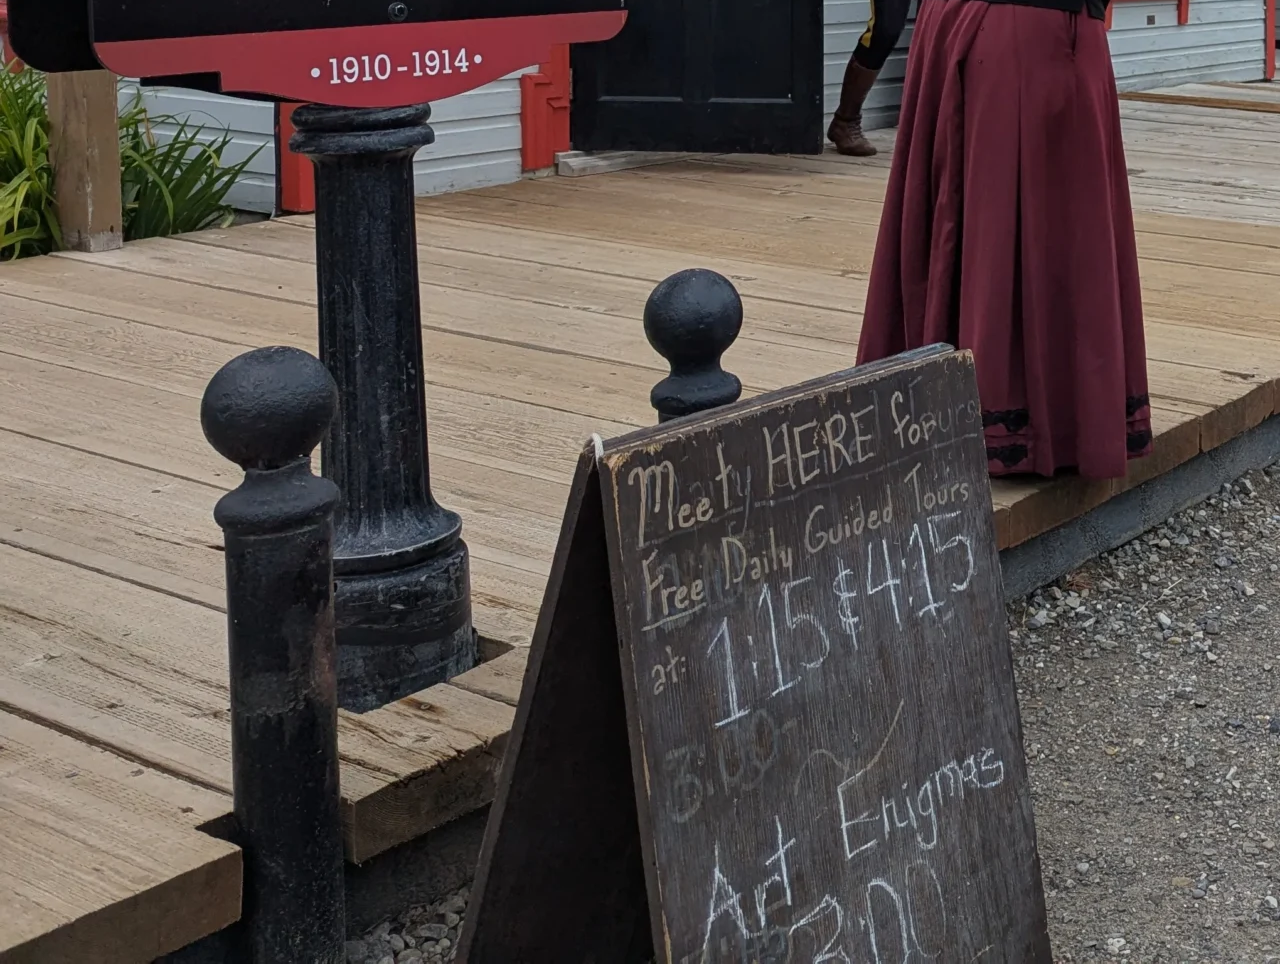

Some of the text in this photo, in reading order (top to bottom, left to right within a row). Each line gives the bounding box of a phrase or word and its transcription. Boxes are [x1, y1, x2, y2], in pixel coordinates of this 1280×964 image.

[627, 440, 734, 550] Meet
[763, 405, 876, 496] HERE
[890, 389, 936, 449] for
[640, 547, 705, 623] Free
[720, 526, 795, 591] Daily
[804, 484, 894, 556] Guided
[904, 462, 970, 514] Tours
[707, 574, 832, 729] 1:15
[866, 510, 977, 638] 4:15
[700, 814, 797, 964] Art
[837, 745, 1006, 861] Enigmas
